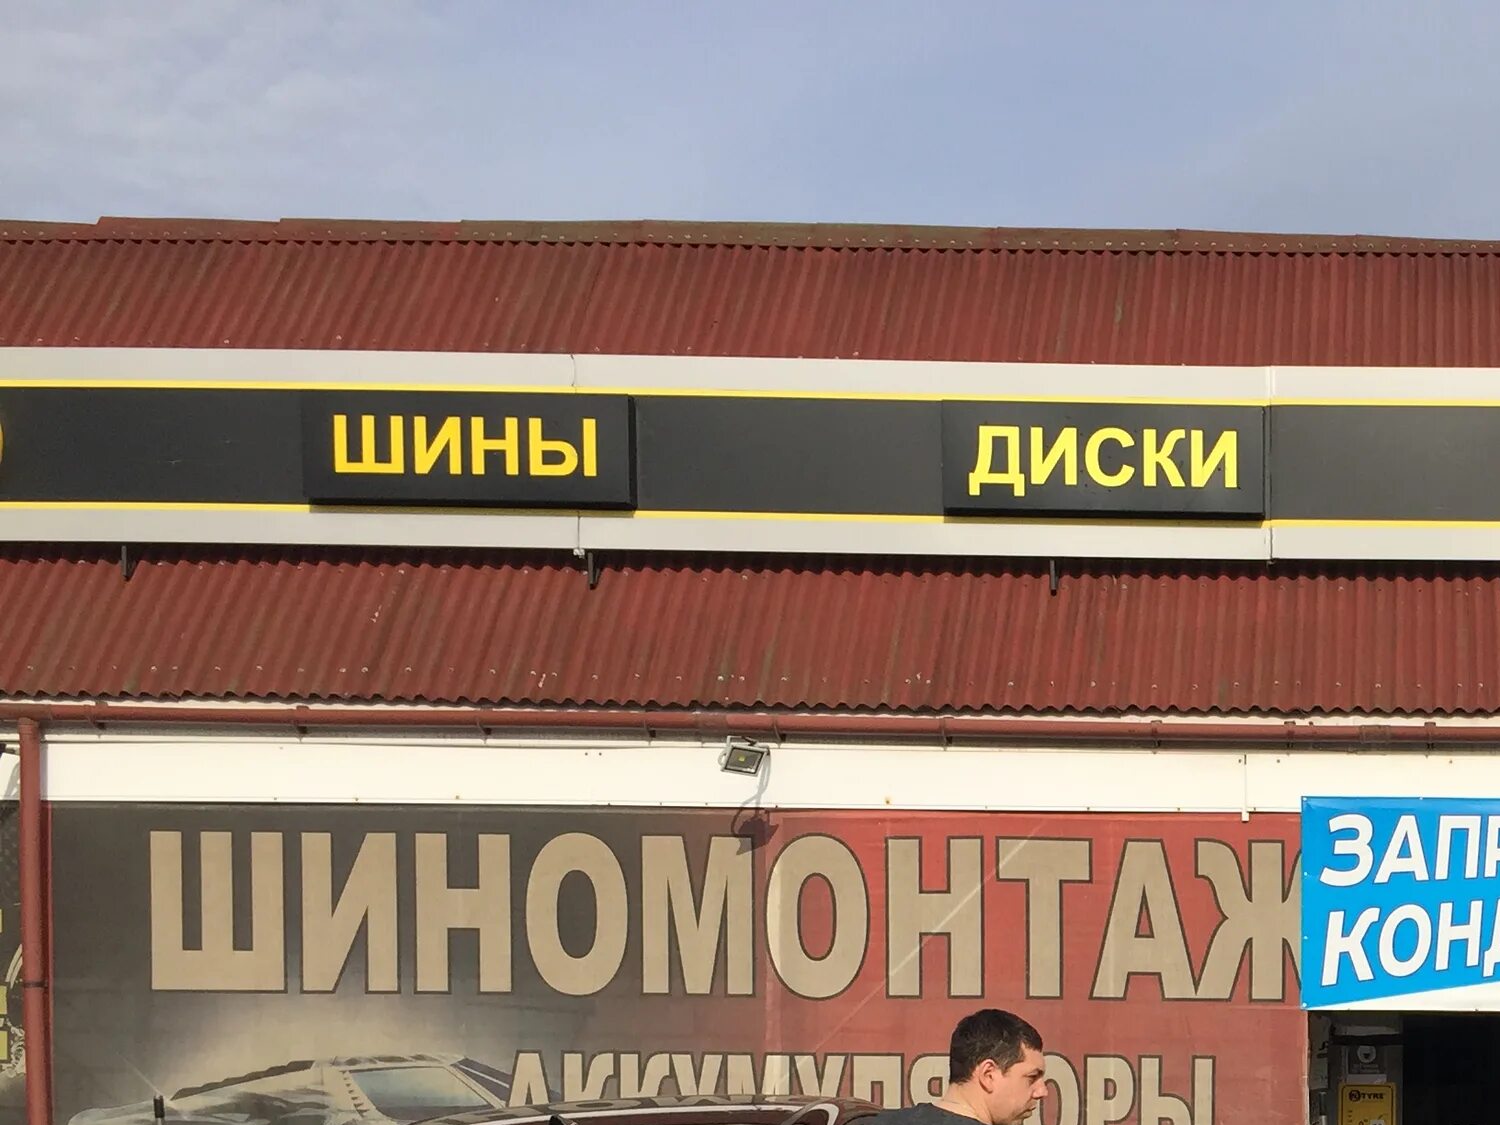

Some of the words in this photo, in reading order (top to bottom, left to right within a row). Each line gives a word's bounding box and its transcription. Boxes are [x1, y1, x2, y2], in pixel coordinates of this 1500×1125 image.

[333, 414, 597, 477] ШИНЫ
[968, 425, 1237, 497] ДИСКИ
[149, 829, 1301, 1001] ШИНОМОНТАЖ
